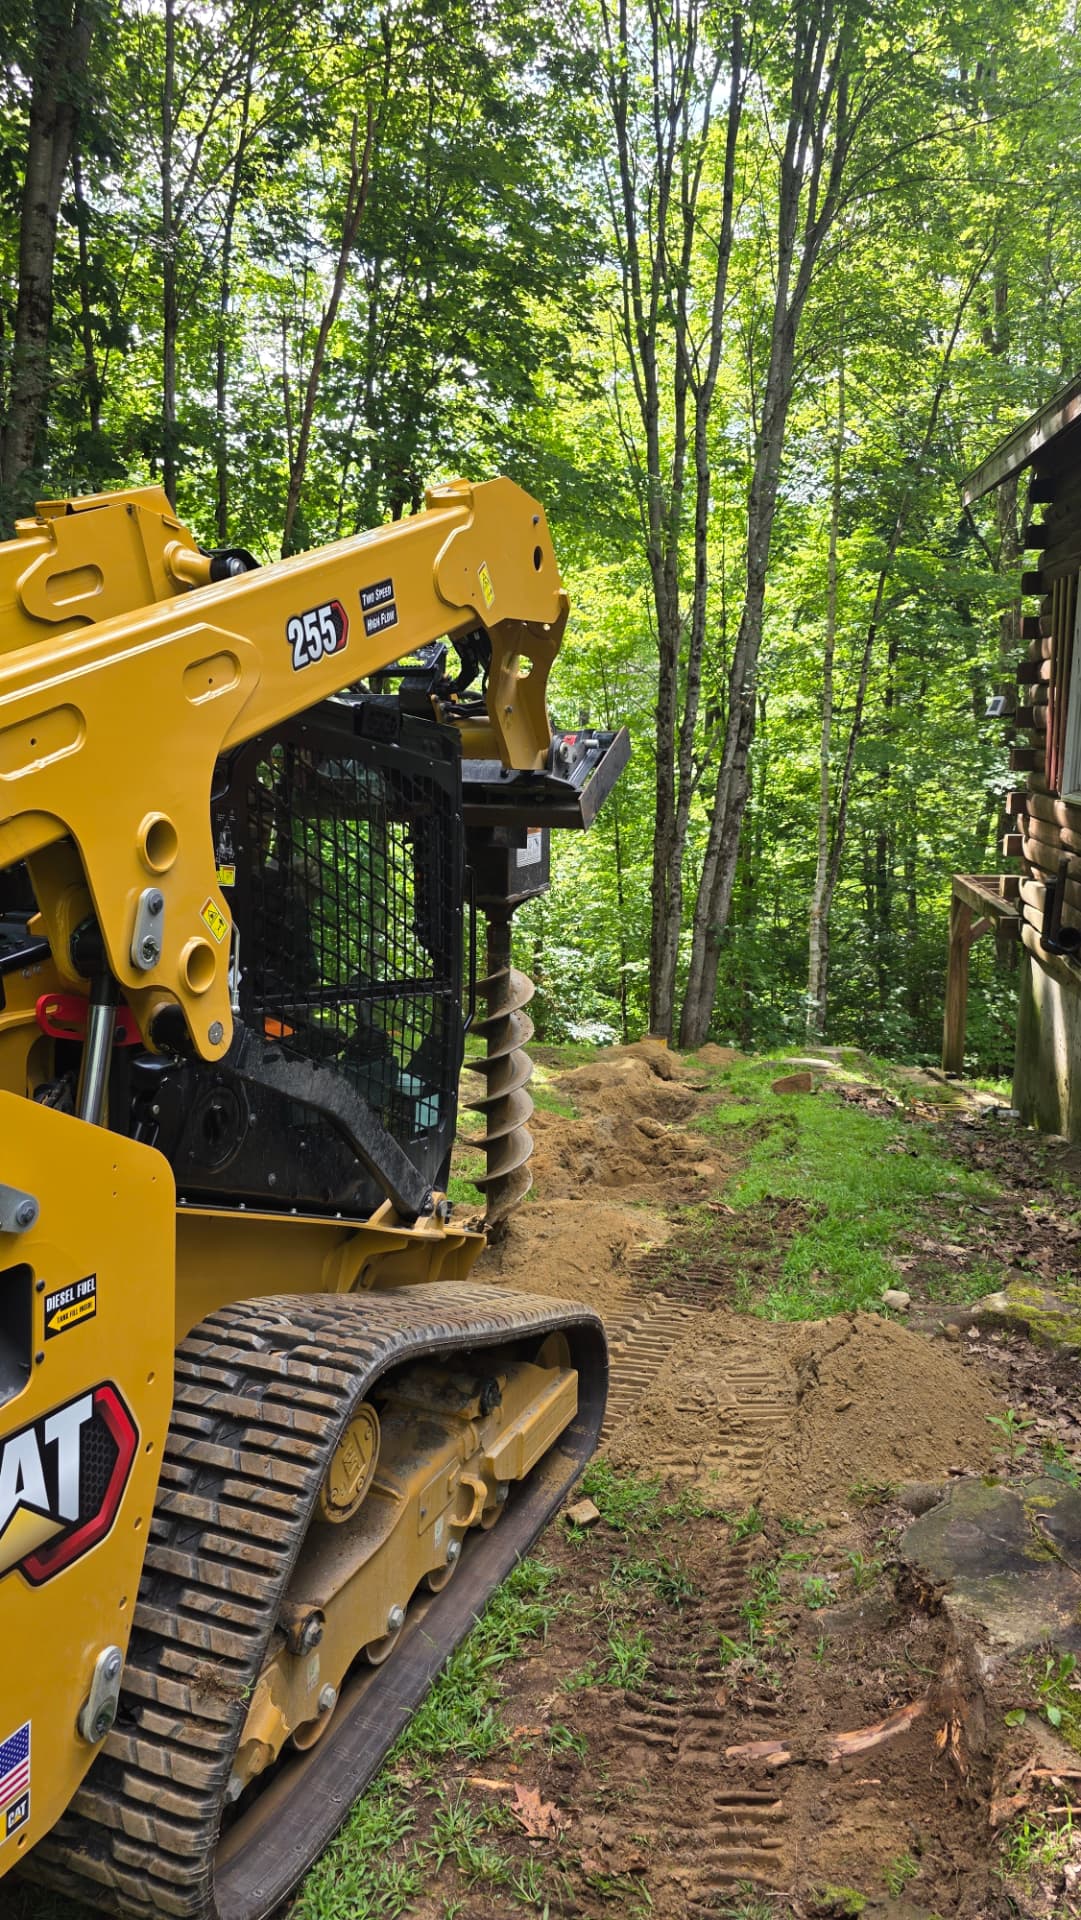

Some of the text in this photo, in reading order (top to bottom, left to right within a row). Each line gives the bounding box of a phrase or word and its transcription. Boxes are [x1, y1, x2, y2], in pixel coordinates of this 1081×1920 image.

[288, 605, 336, 668] 255
[47, 1278, 95, 1312] DIESEL FUEL
[0, 1393, 92, 1531] AT
[8, 1800, 26, 1828] CAT
